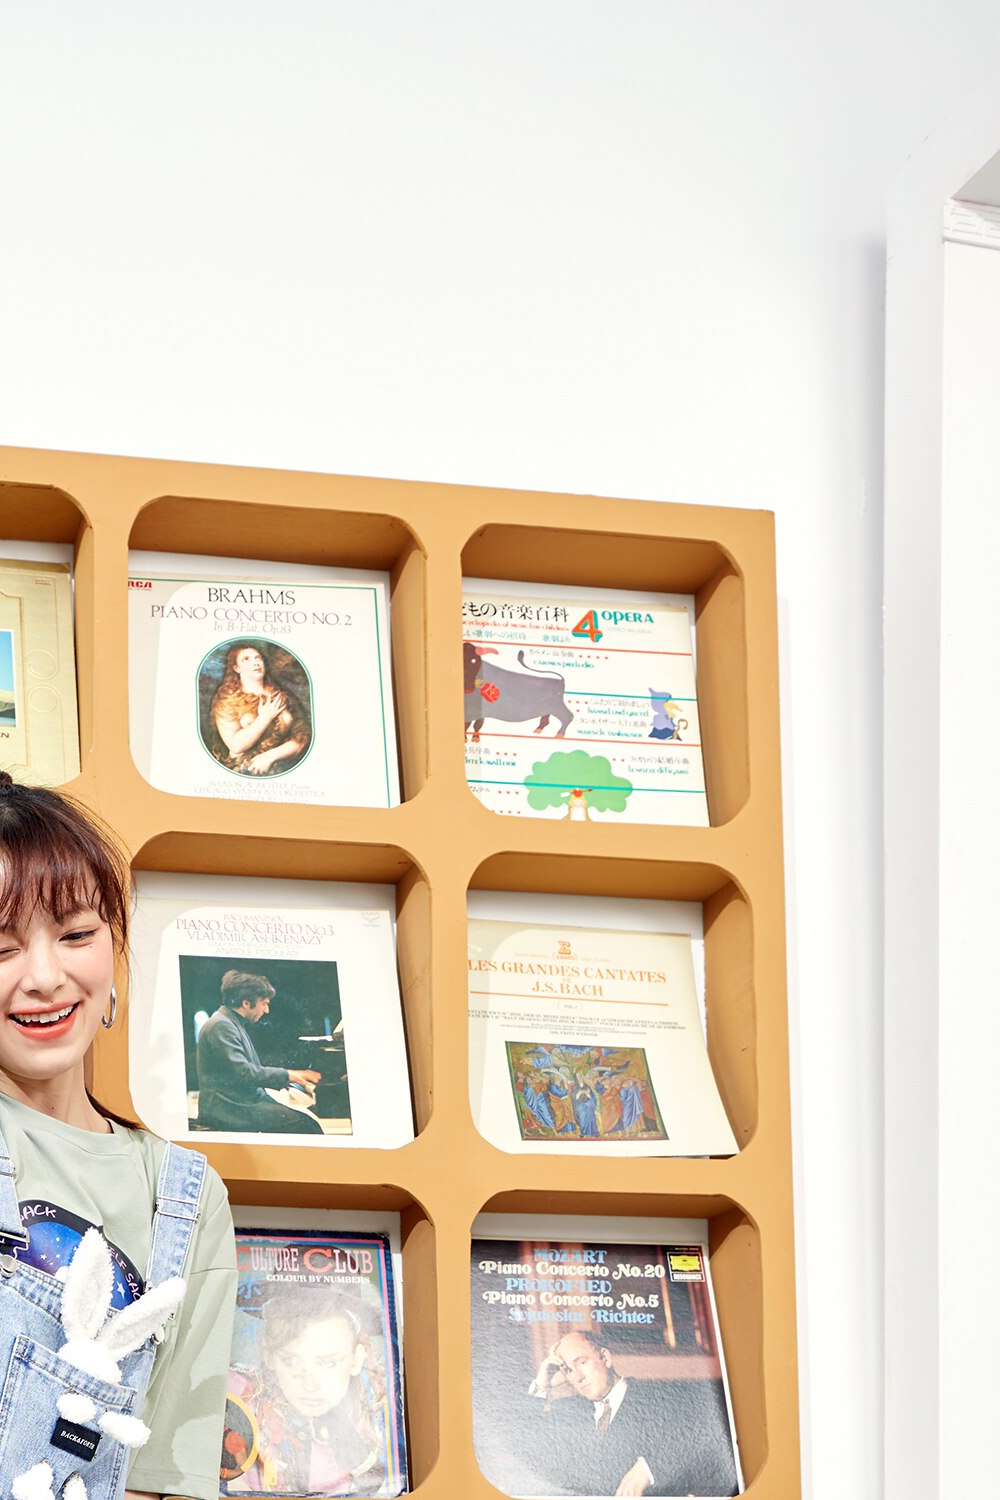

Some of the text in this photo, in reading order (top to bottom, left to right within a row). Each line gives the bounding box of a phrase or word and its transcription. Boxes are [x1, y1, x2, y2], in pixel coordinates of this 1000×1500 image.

[208, 587, 297, 606] BRAHMS
[151, 604, 208, 620] PIANO
[213, 607, 308, 624] CONCERTO
[571, 609, 603, 643] 4
[176, 918, 221, 932] PIANO
[223, 920, 303, 936] CONCERTO
[187, 930, 248, 943] VLADIMIR
[251, 932, 323, 946] ASHKENAZY
[468, 959, 667, 984] LES GRANDES CANTATES
[236, 1245, 374, 1274] CULTURE CLUB
[533, 1248, 608, 1264] MOZART
[266, 1273, 371, 1284] COLOUR BY NUMBERS
[478, 1260, 666, 1281] Piano Concerto No.20
[482, 1291, 660, 1311] Piano Concerto No.5
[590, 1309, 656, 1325] Richter
